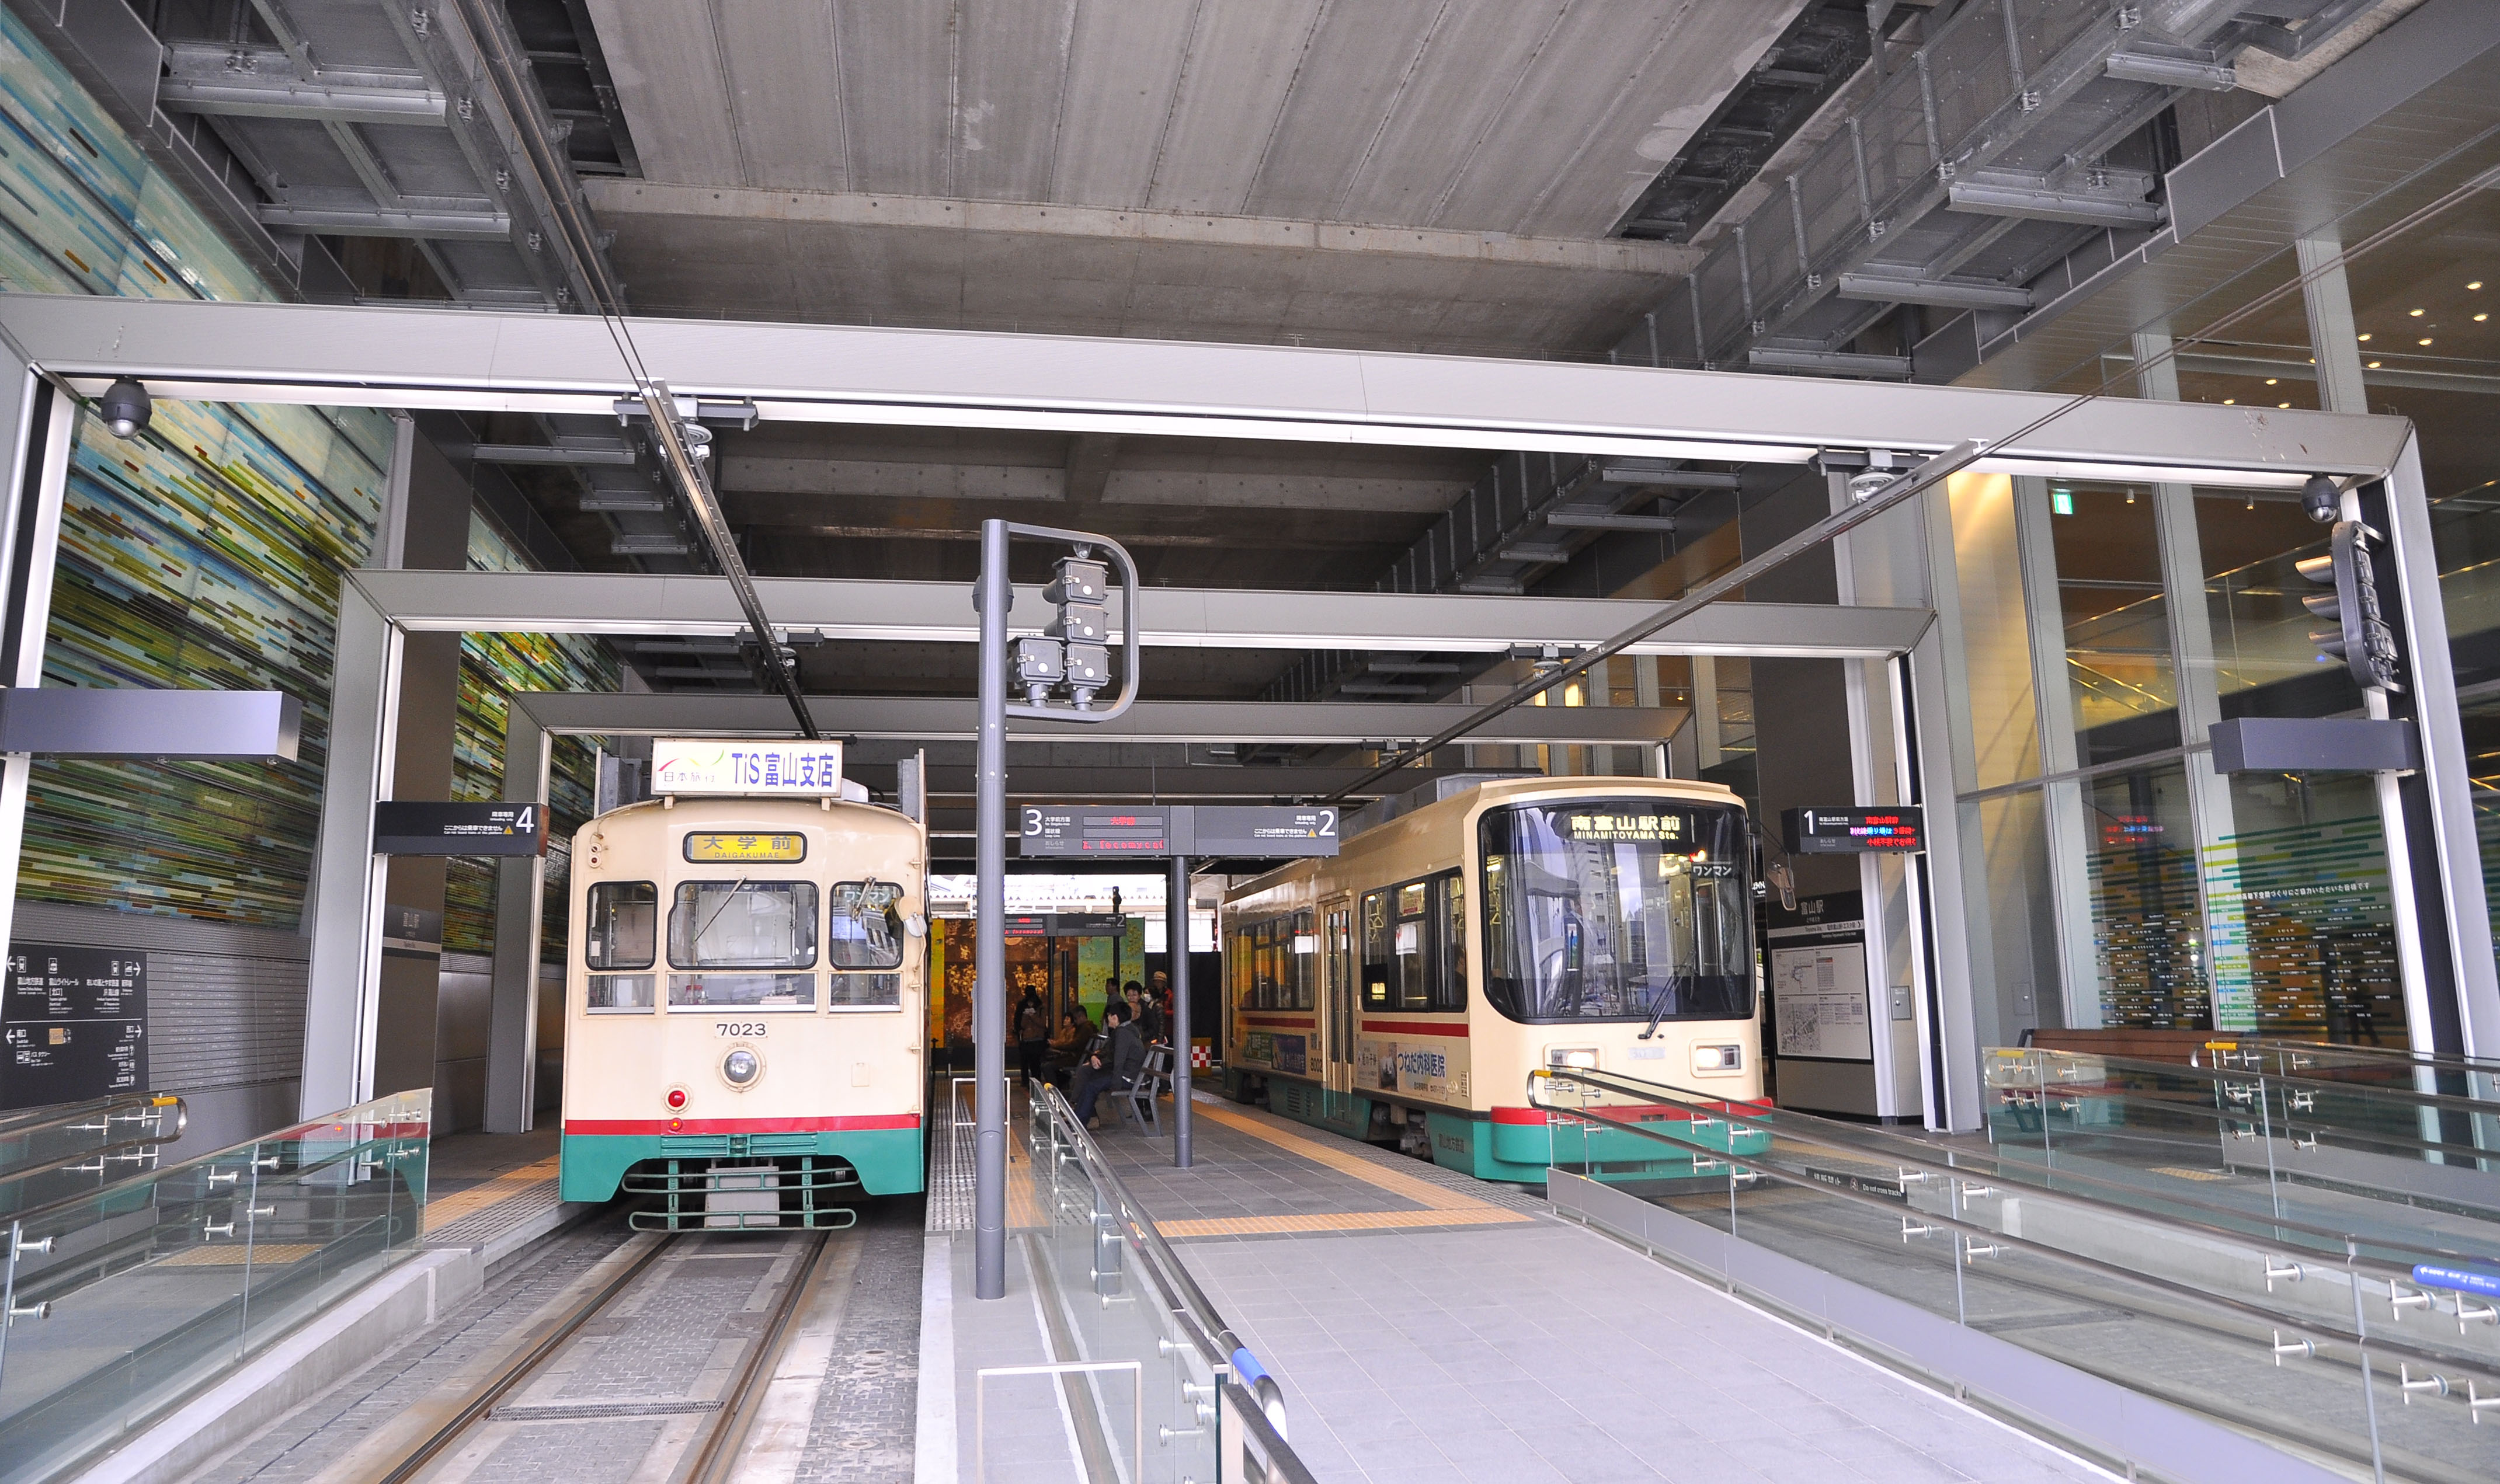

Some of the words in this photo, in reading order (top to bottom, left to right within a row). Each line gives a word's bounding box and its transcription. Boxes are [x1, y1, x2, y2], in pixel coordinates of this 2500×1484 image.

[664, 772, 715, 783] 日本旅行
[516, 806, 535, 834] 4
[1024, 809, 1042, 836] 3
[1110, 816, 1136, 826] 大学前
[1319, 810, 1336, 837] 2
[1570, 815, 1681, 831] 南富山駅前
[1803, 810, 1814, 835] 1
[703, 835, 791, 850] 大学前
[1573, 831, 1655, 839] MINAMITOYAMA
[1658, 831, 1680, 840] Sta.
[1692, 866, 1732, 876] ワンマン
[1800, 899, 1824, 915] 富山駅
[716, 1023, 766, 1037] 7023
[1397, 1051, 1446, 1078] つねだ内科医院
